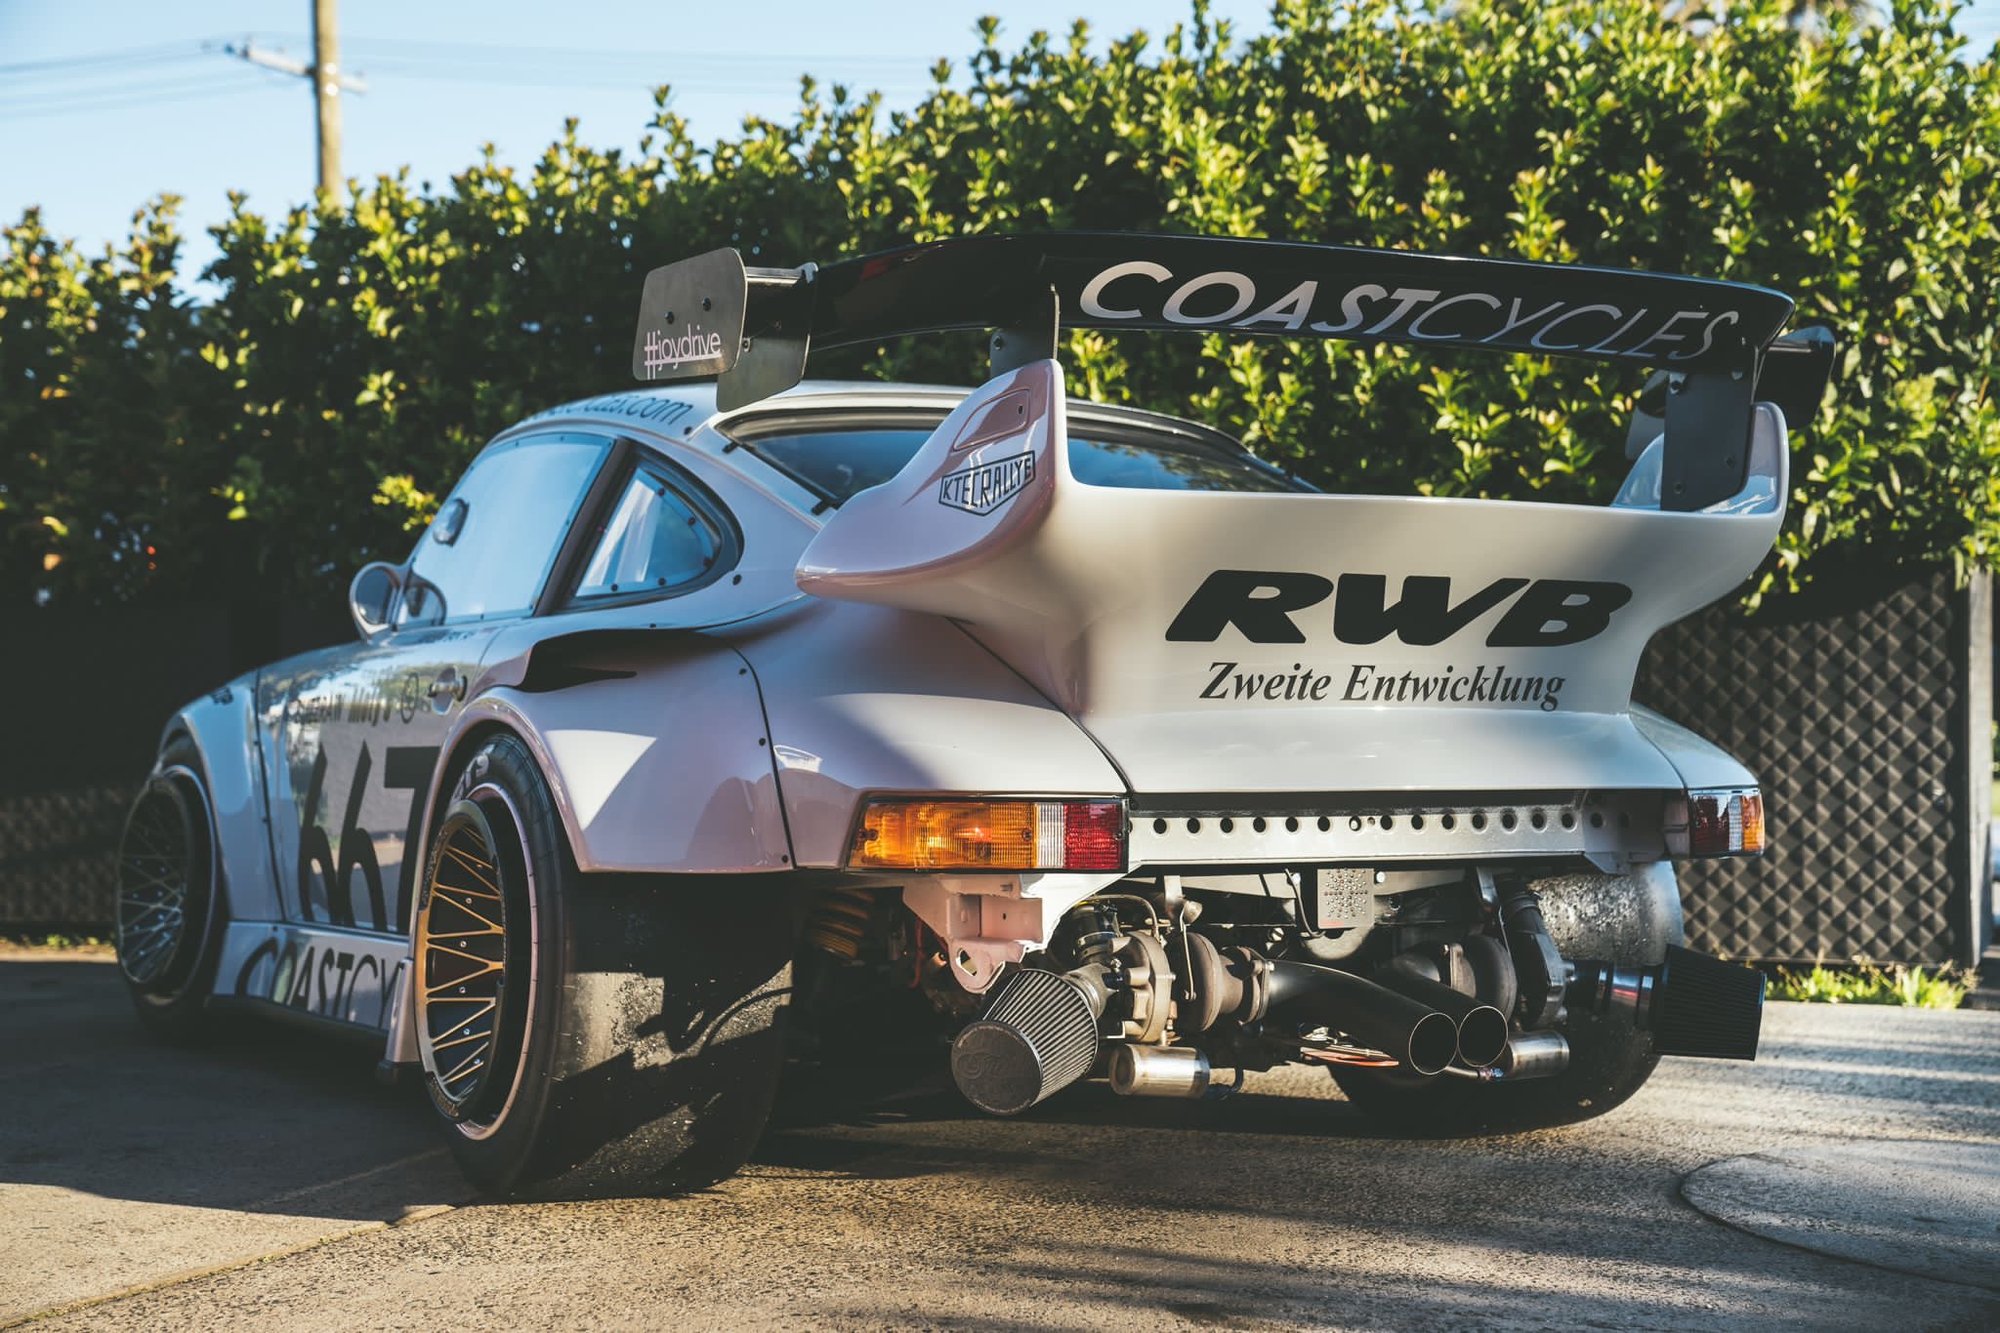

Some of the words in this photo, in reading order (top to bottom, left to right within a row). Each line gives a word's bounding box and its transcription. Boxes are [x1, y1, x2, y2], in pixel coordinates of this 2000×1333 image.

[1079, 261, 1738, 359] COASTCYCLES
[644, 323, 722, 380] #joydrive
[1165, 569, 1633, 647] RWB
[1199, 662, 1332, 702] Zweite
[1340, 664, 1566, 712] Entwicklung
